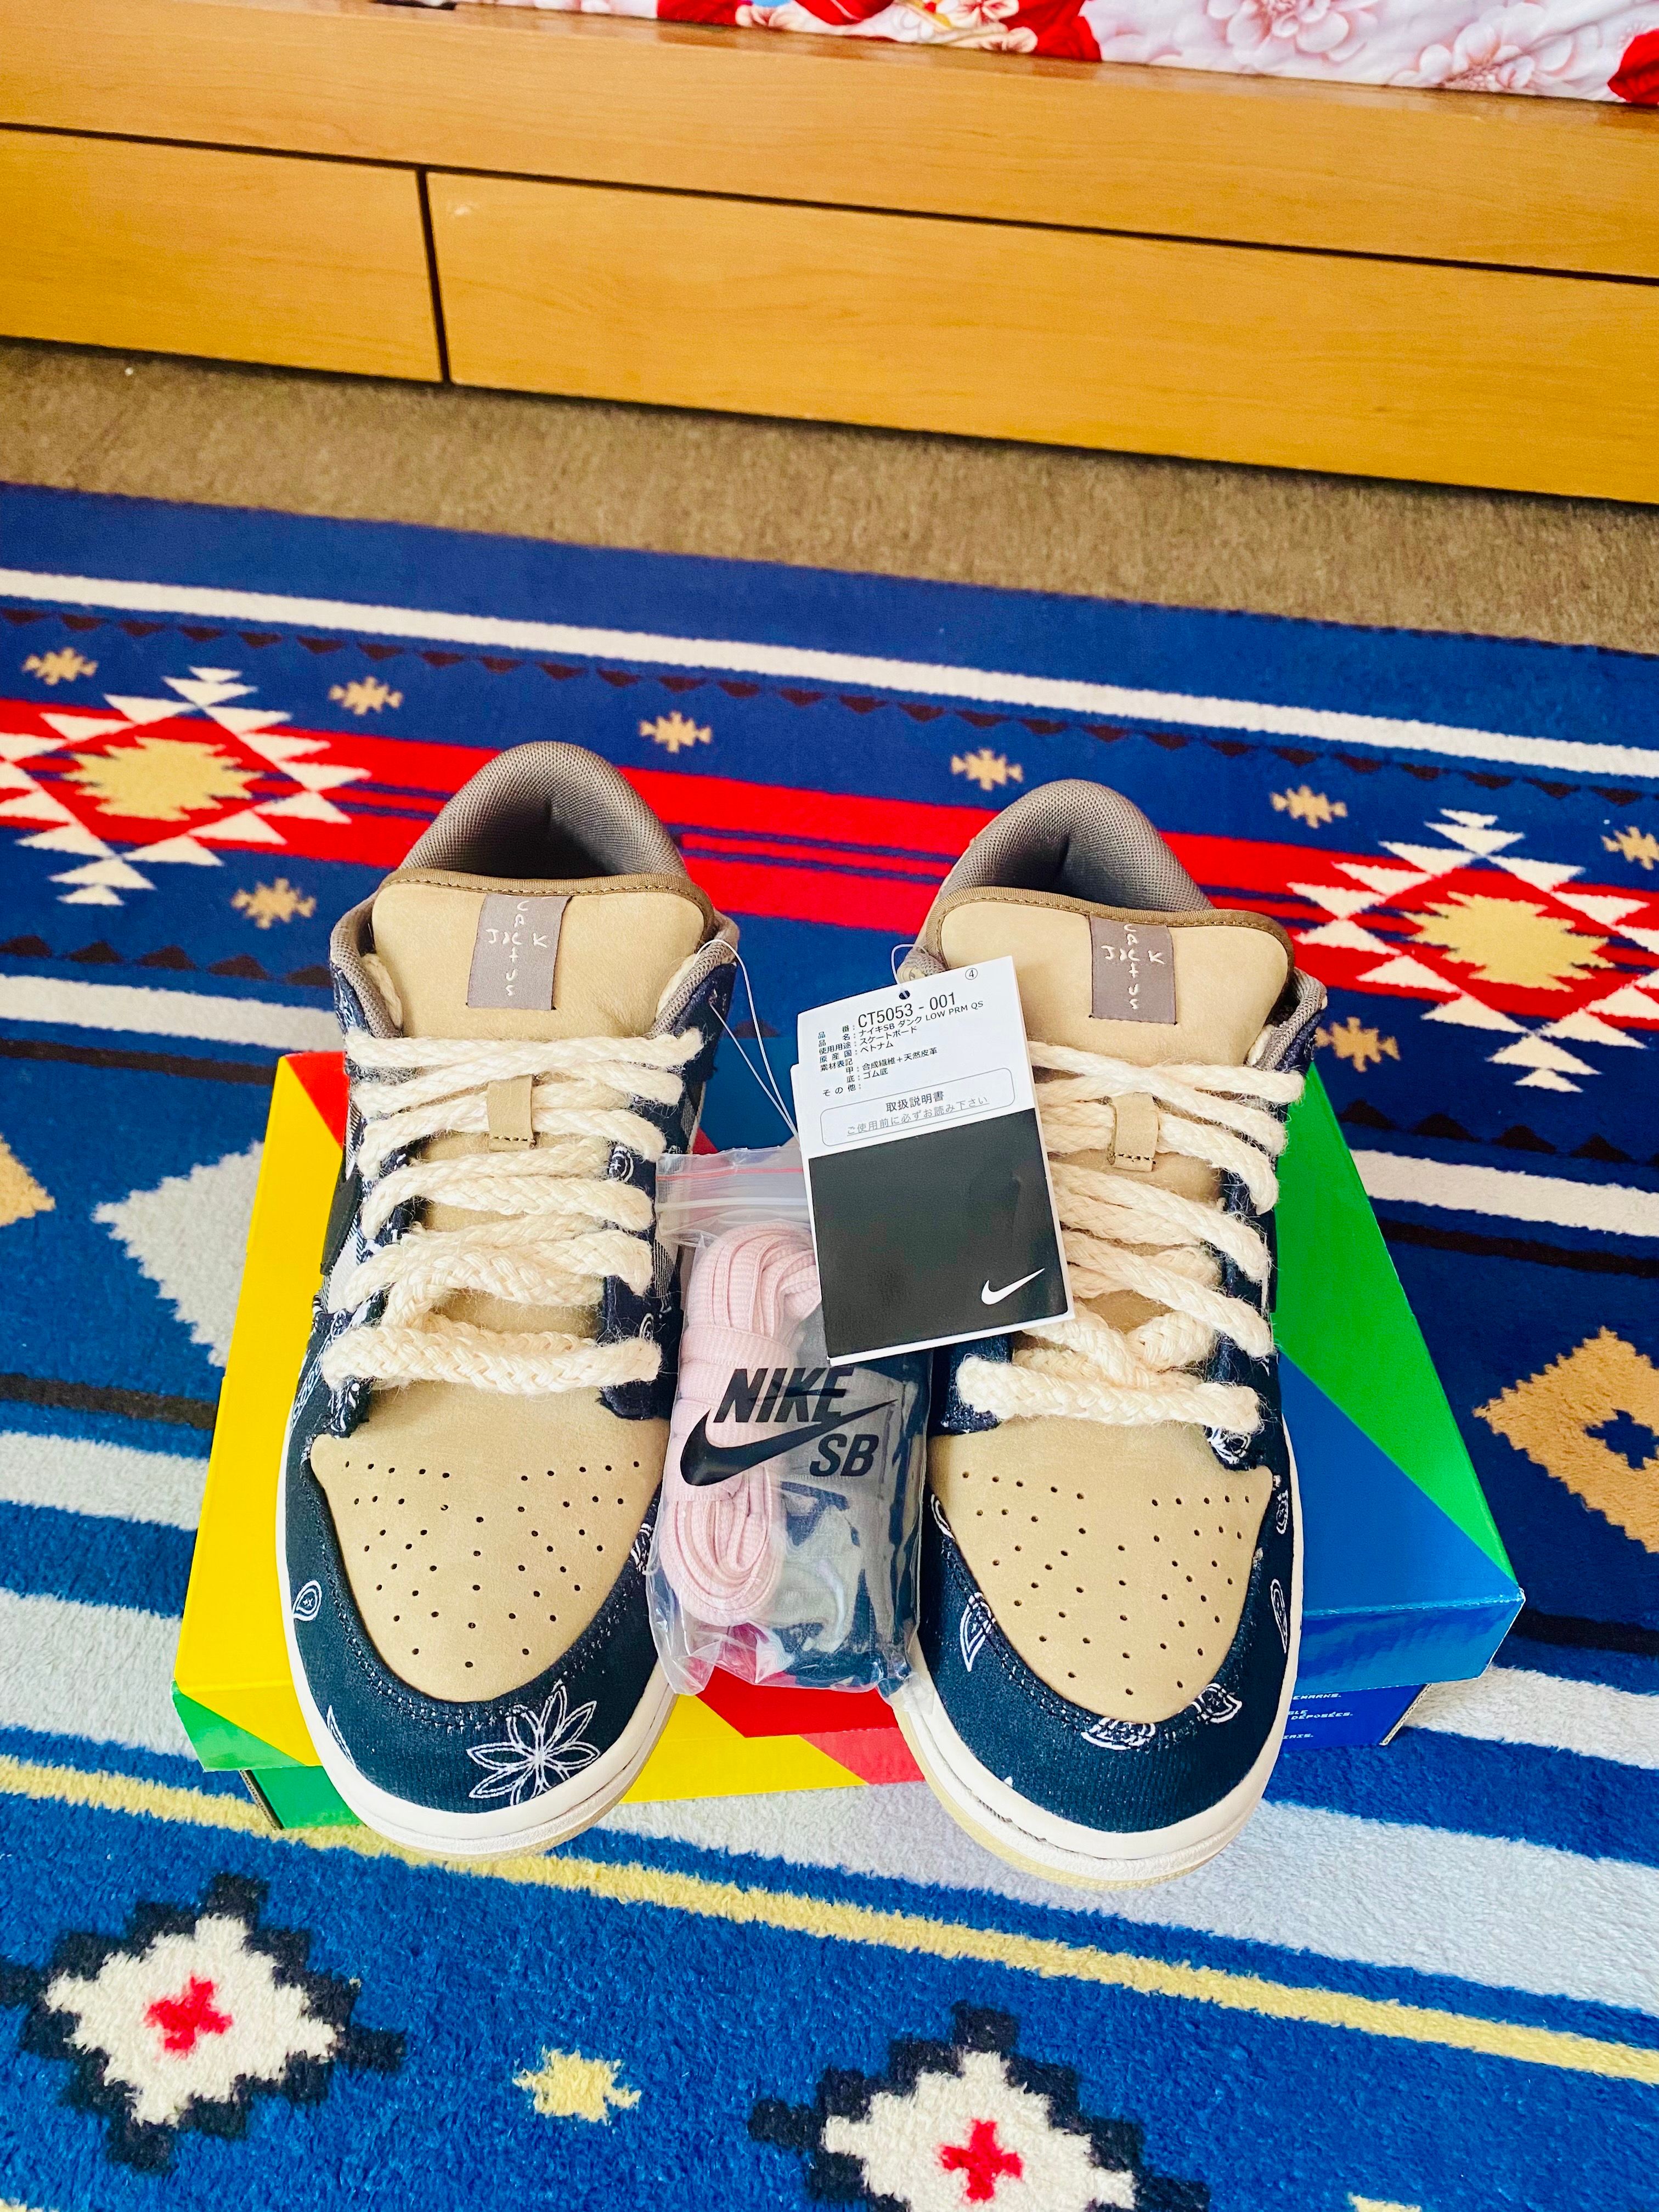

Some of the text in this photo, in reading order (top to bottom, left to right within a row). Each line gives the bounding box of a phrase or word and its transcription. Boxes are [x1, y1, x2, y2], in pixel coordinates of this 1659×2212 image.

[926, 1011, 946, 1022] LOW
[949, 1005, 968, 1015] PRM
[971, 1000, 984, 1009] QS
[885, 1091, 945, 1113] 取扱説明書
[713, 1367, 855, 1423] NIKE
[809, 1432, 880, 1477] SB
